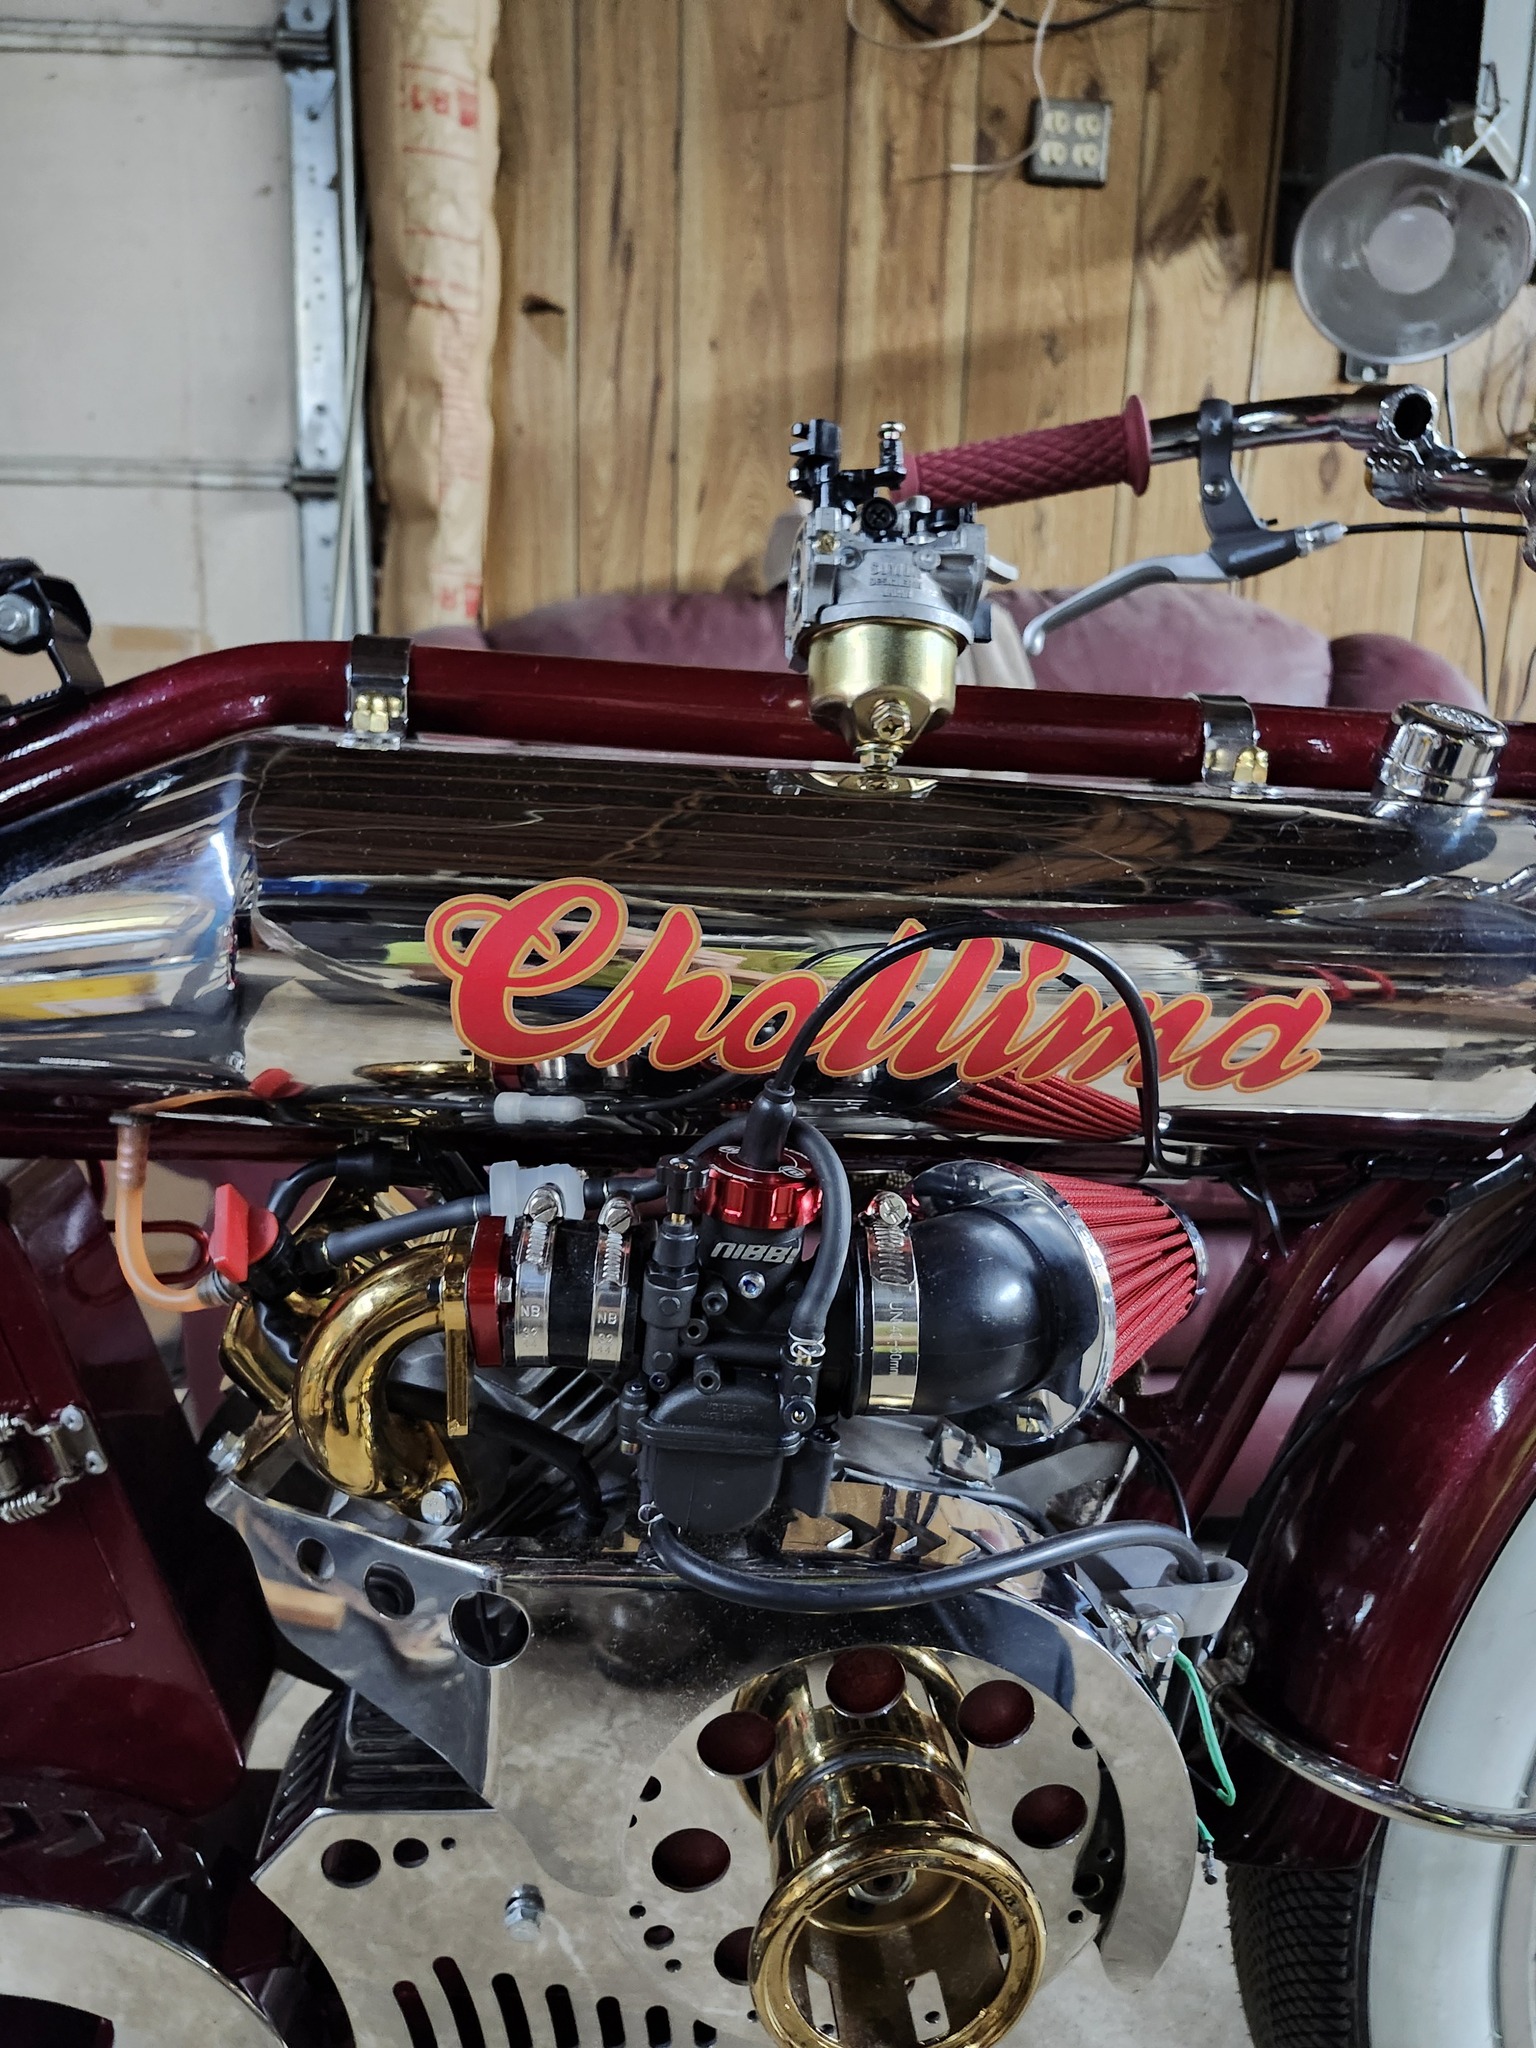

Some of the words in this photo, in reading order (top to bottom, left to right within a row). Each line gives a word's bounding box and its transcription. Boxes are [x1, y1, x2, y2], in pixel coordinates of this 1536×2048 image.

[424, 876, 1332, 1093] Chollima
[711, 1241, 800, 1264] NIBBI
[520, 1305, 541, 1318] NB
[597, 1312, 618, 1325] NB
